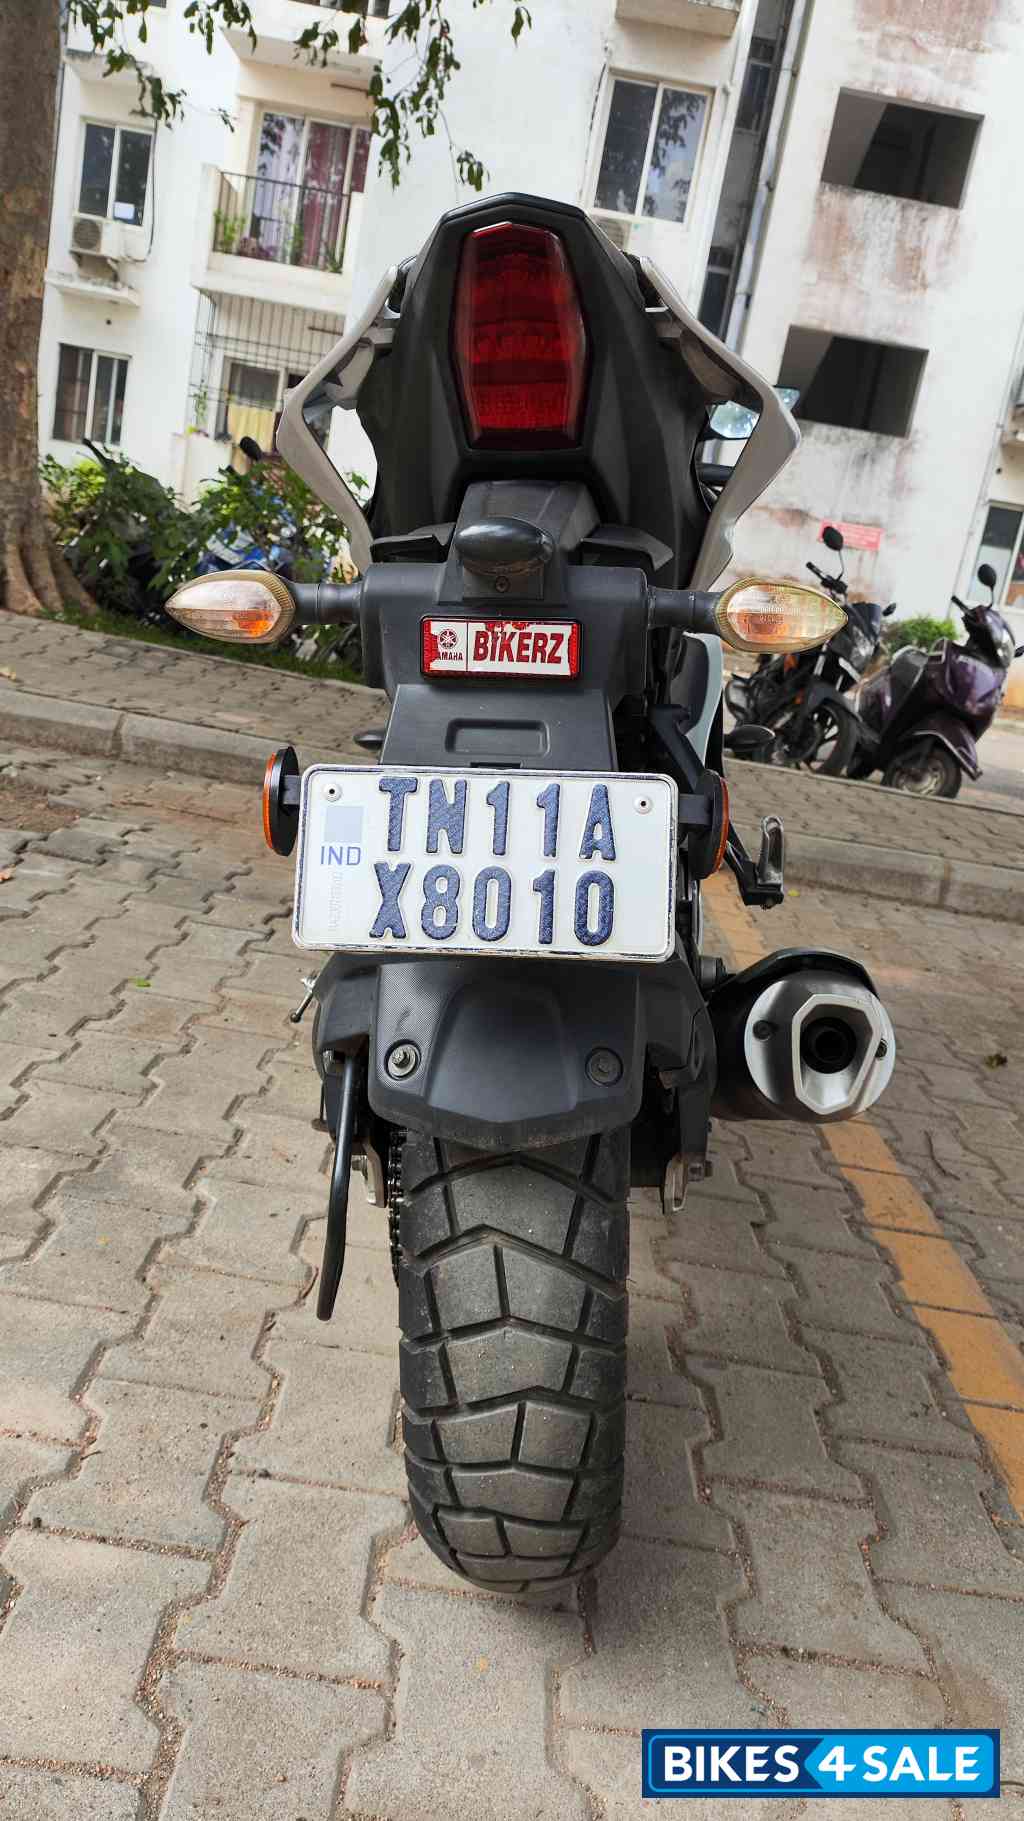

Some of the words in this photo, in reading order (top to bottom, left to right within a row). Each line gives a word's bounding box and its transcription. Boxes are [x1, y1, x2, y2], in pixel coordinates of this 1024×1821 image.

[435, 651, 463, 661] AMAHA
[472, 630, 564, 664] BIKERZ
[378, 776, 617, 861] TN11A
[320, 845, 362, 866] IND
[368, 862, 616, 946] X8010
